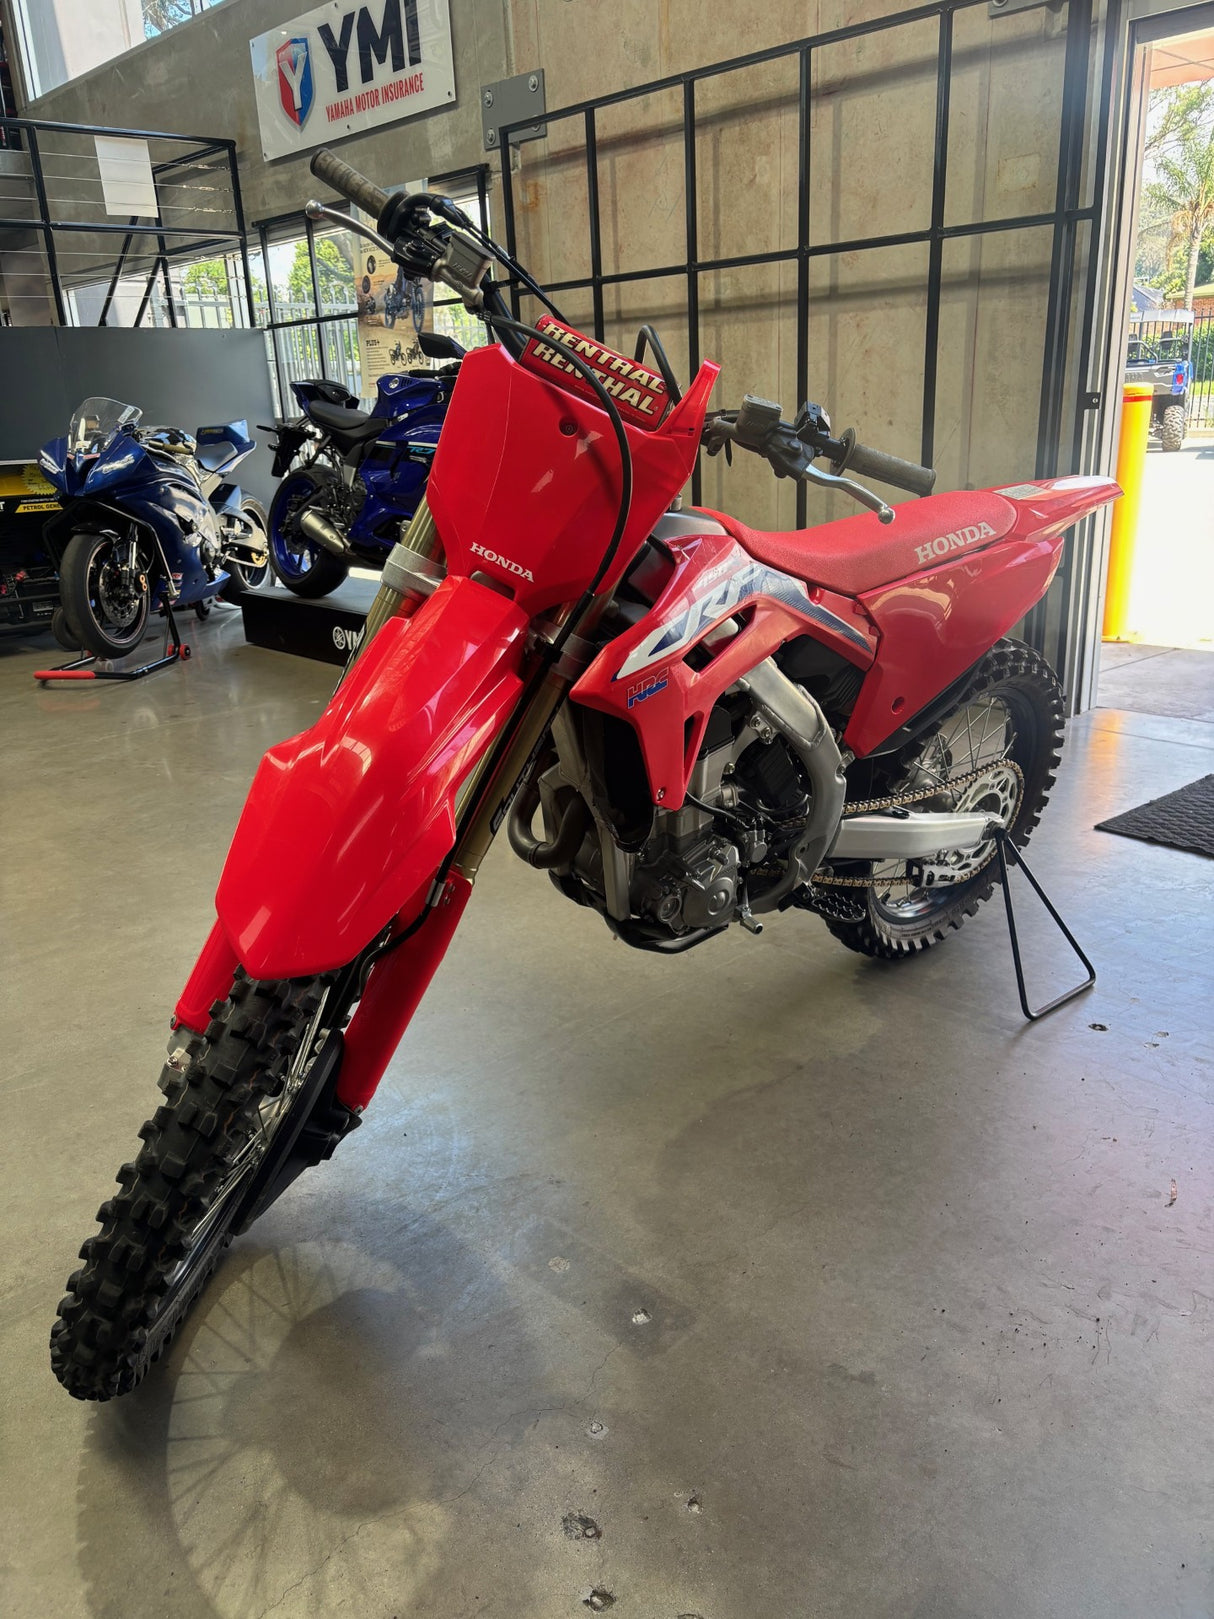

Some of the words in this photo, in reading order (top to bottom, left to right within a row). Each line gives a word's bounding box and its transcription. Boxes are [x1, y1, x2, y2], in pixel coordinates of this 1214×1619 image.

[317, 0, 422, 93] YMI
[325, 97, 355, 123] YAMAHA
[354, 88, 381, 114] MOTOR
[381, 72, 424, 105] INSURANCE
[542, 322, 665, 394] RENTHAL
[469, 541, 535, 583] HONDA
[914, 521, 997, 565] HONDA
[627, 666, 670, 709] HRC
